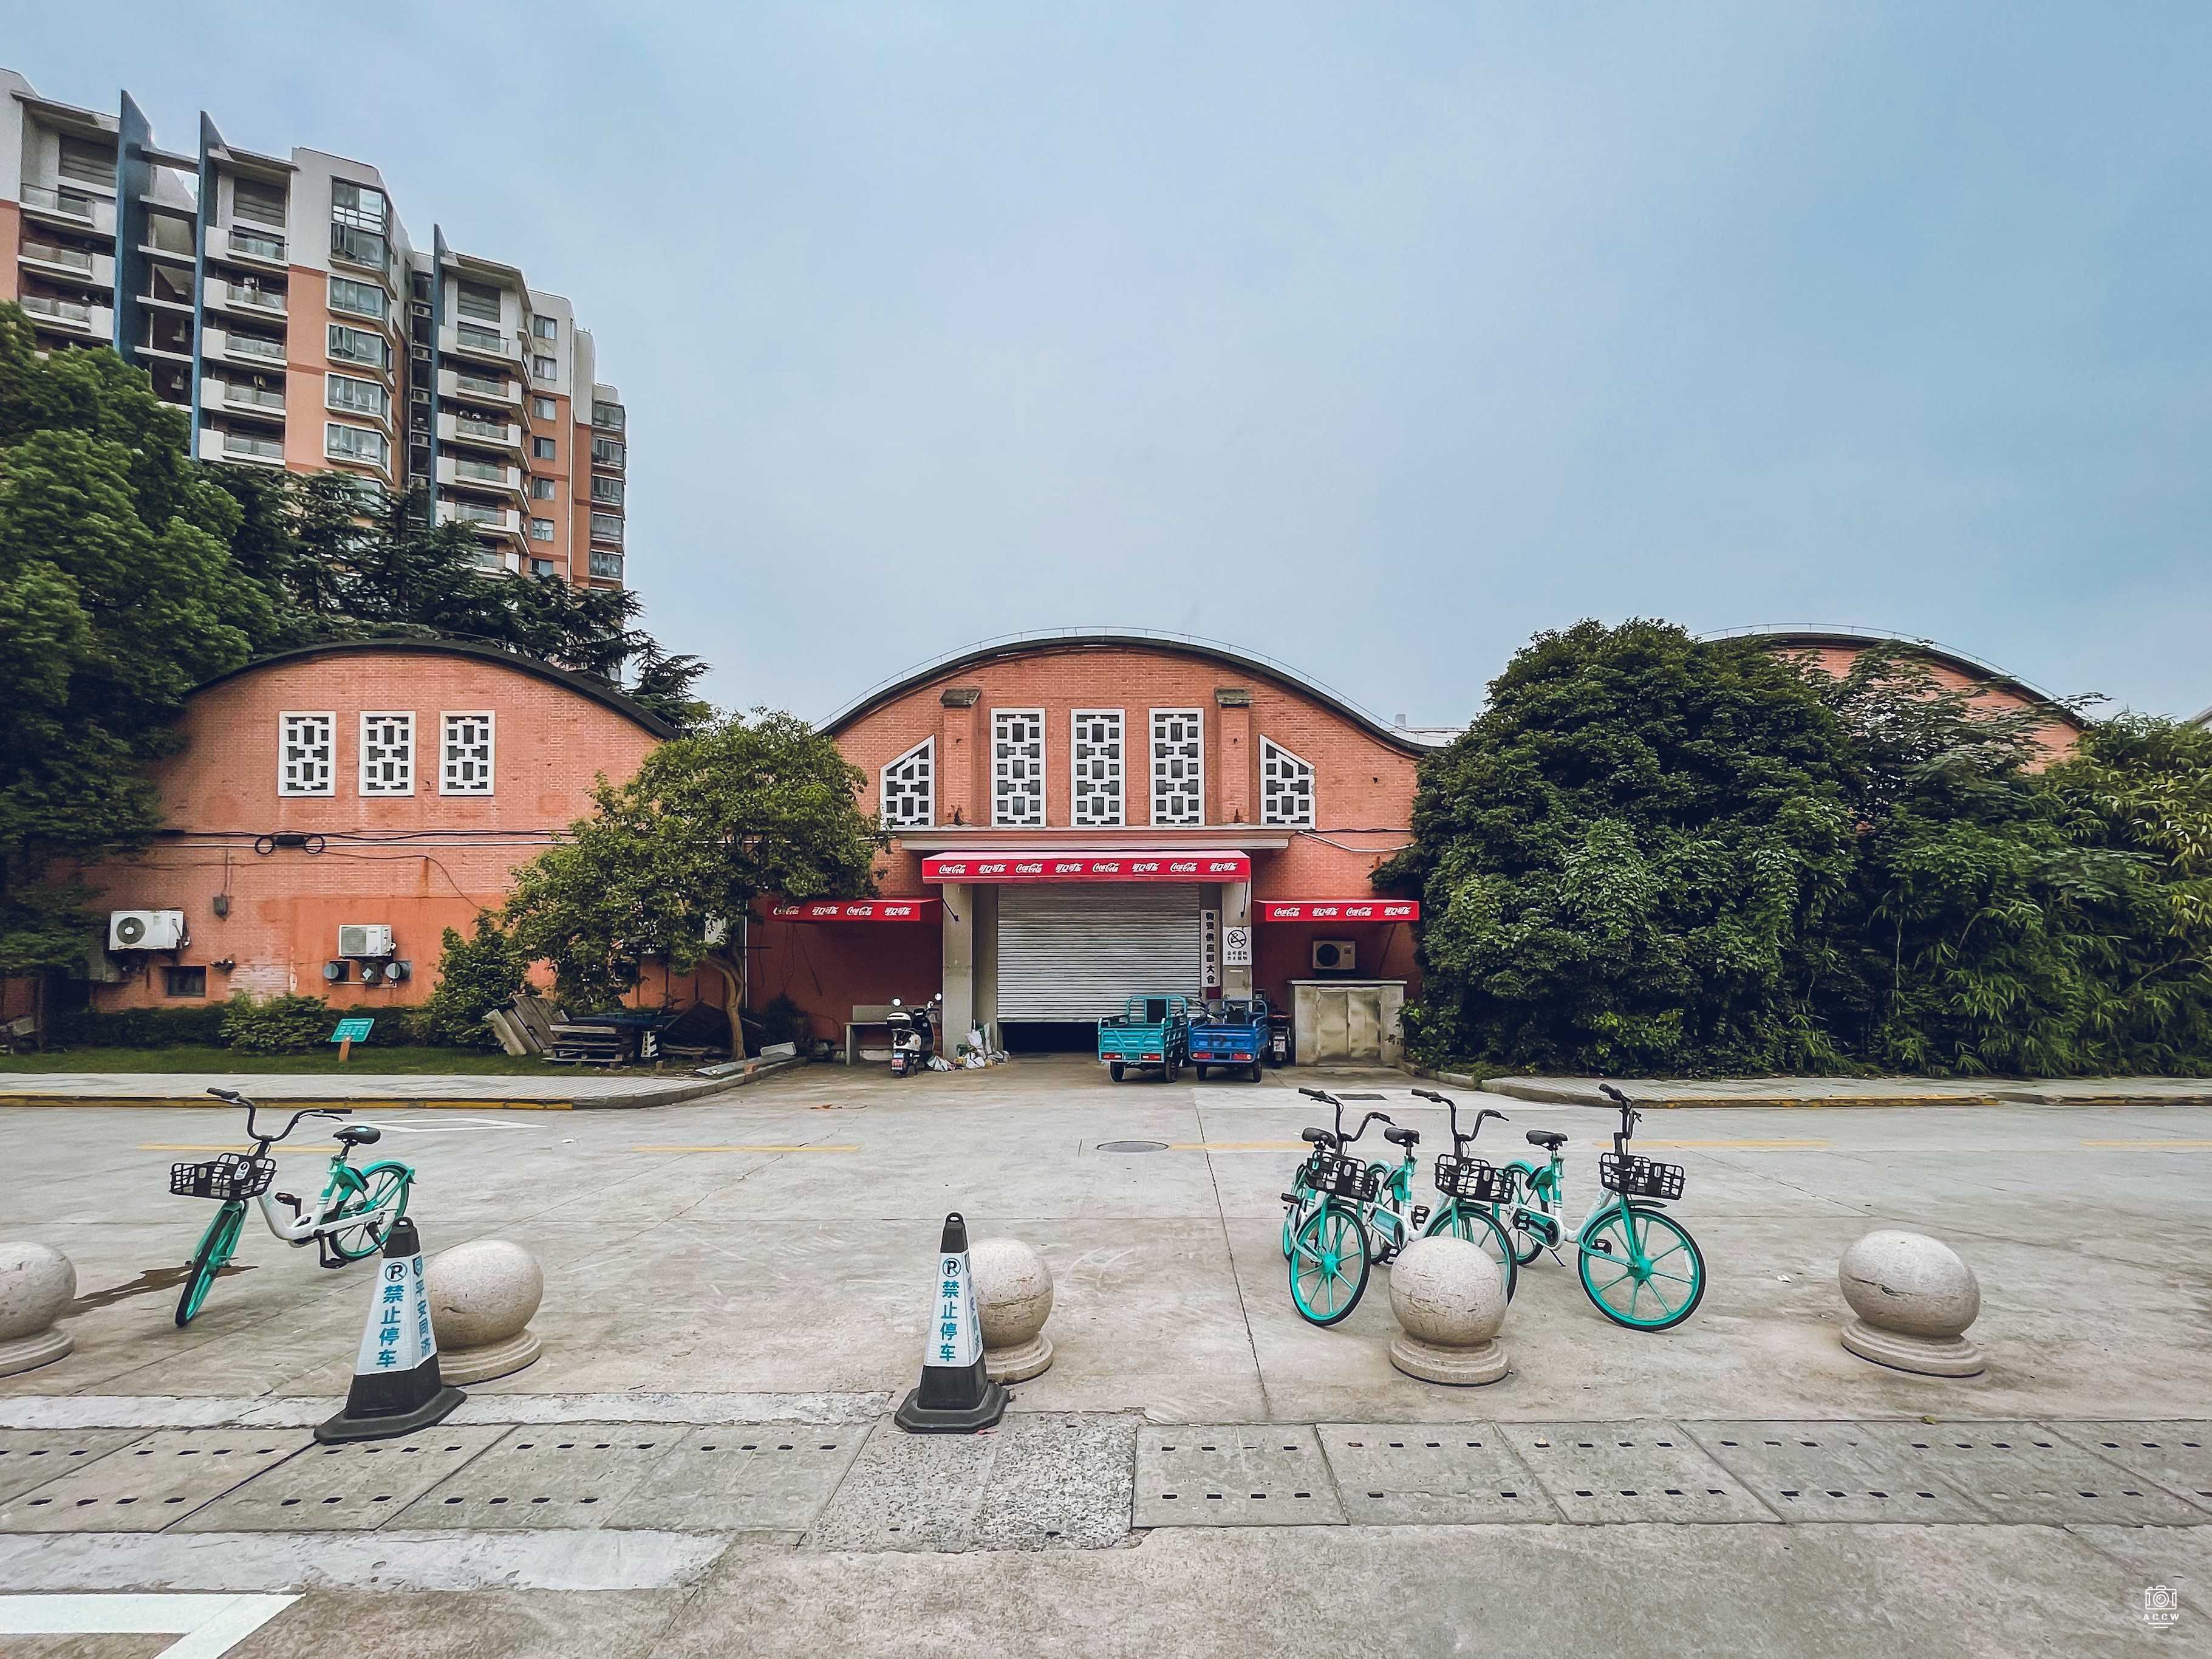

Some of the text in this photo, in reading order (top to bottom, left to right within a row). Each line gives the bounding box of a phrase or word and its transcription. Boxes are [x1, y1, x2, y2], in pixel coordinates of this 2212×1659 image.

[978, 864, 1007, 874] 可口可乐
[1056, 863, 1084, 873] 可口可乐
[1132, 863, 1160, 872] 可口可乐
[1209, 862, 1238, 872] 可口可乐
[811, 906, 839, 915] 可口可乐
[884, 906, 912, 916] 可口可乐
[1312, 907, 1339, 917] 可口可乐
[1384, 906, 1412, 916] 可口可乐
[377, 1284, 405, 1367] 禁止停车
[940, 1280, 959, 1362] 禁止停车
